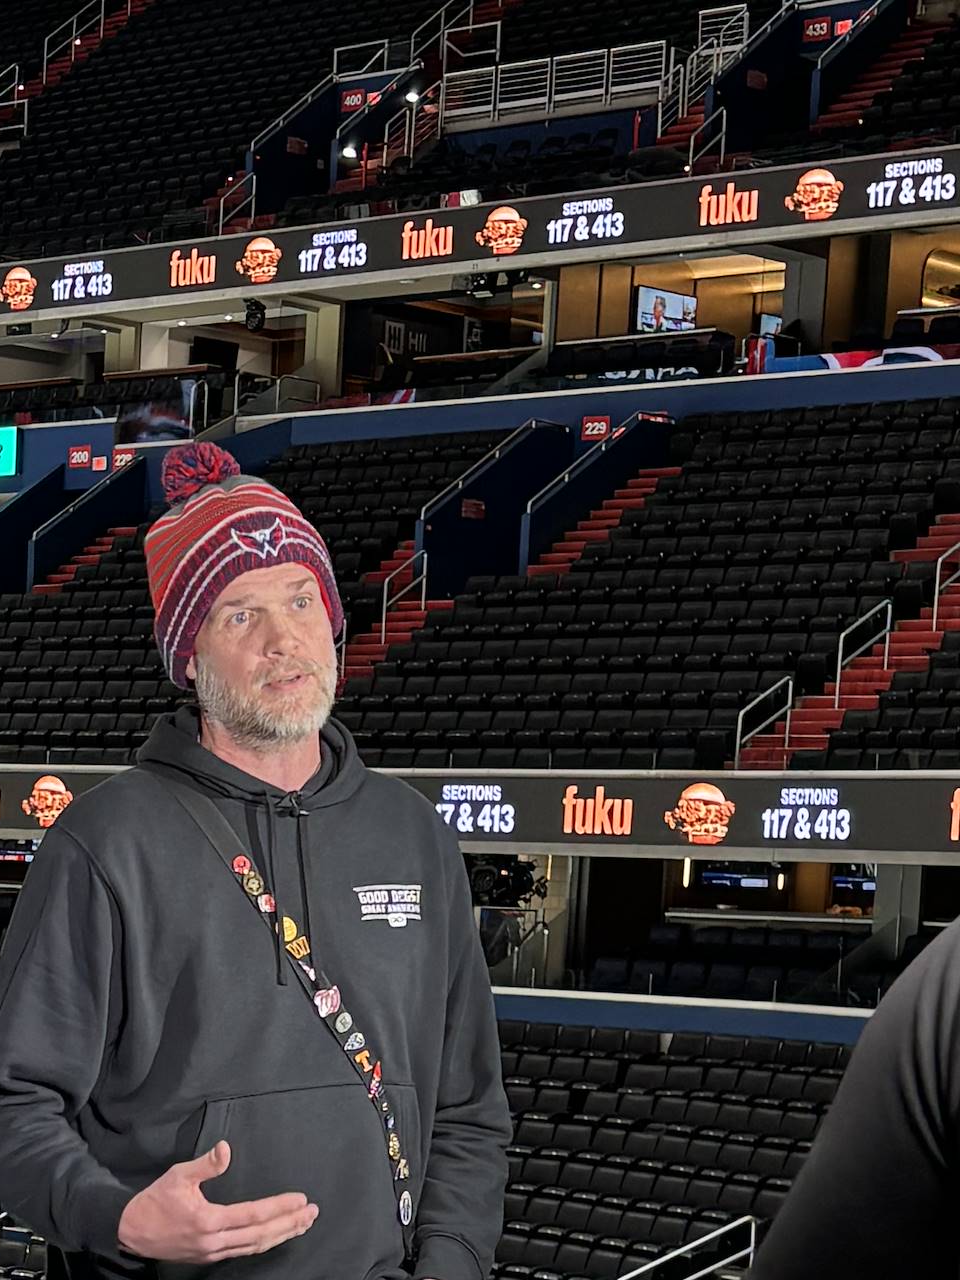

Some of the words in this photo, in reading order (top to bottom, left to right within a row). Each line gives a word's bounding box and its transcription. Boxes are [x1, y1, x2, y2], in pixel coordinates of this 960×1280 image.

[806, 22, 827, 37] 433
[344, 93, 362, 106] 400
[885, 158, 943, 179] SECTIONS
[866, 180, 898, 208] 117
[898, 177, 916, 205] &
[918, 173, 956, 202] 413
[562, 197, 614, 217] SECTIONS
[699, 183, 759, 227] fuku
[312, 229, 358, 247] SECTIONS
[546, 218, 574, 244] 117
[574, 215, 589, 241] &
[591, 212, 624, 238] 413
[402, 219, 454, 260] fuku
[64, 260, 104, 276] SECTIONS
[170, 248, 216, 287] fuku
[298, 248, 322, 273] 117
[323, 246, 336, 270] &
[337, 243, 368, 268] 413
[51, 278, 73, 301] 117
[73, 275, 86, 298] &
[87, 273, 112, 297] 413
[584, 421, 606, 435] 229
[71, 450, 89, 463] 200
[442, 785, 502, 802] SECTIONS
[780, 788, 839, 806] SECTIONS
[456, 802, 474, 833] &
[477, 803, 515, 834] 413
[563, 785, 633, 836] fuku
[761, 808, 793, 839] 117
[794, 807, 811, 840] &
[814, 808, 851, 840] 413
[358, 890, 389, 904] GOOD
